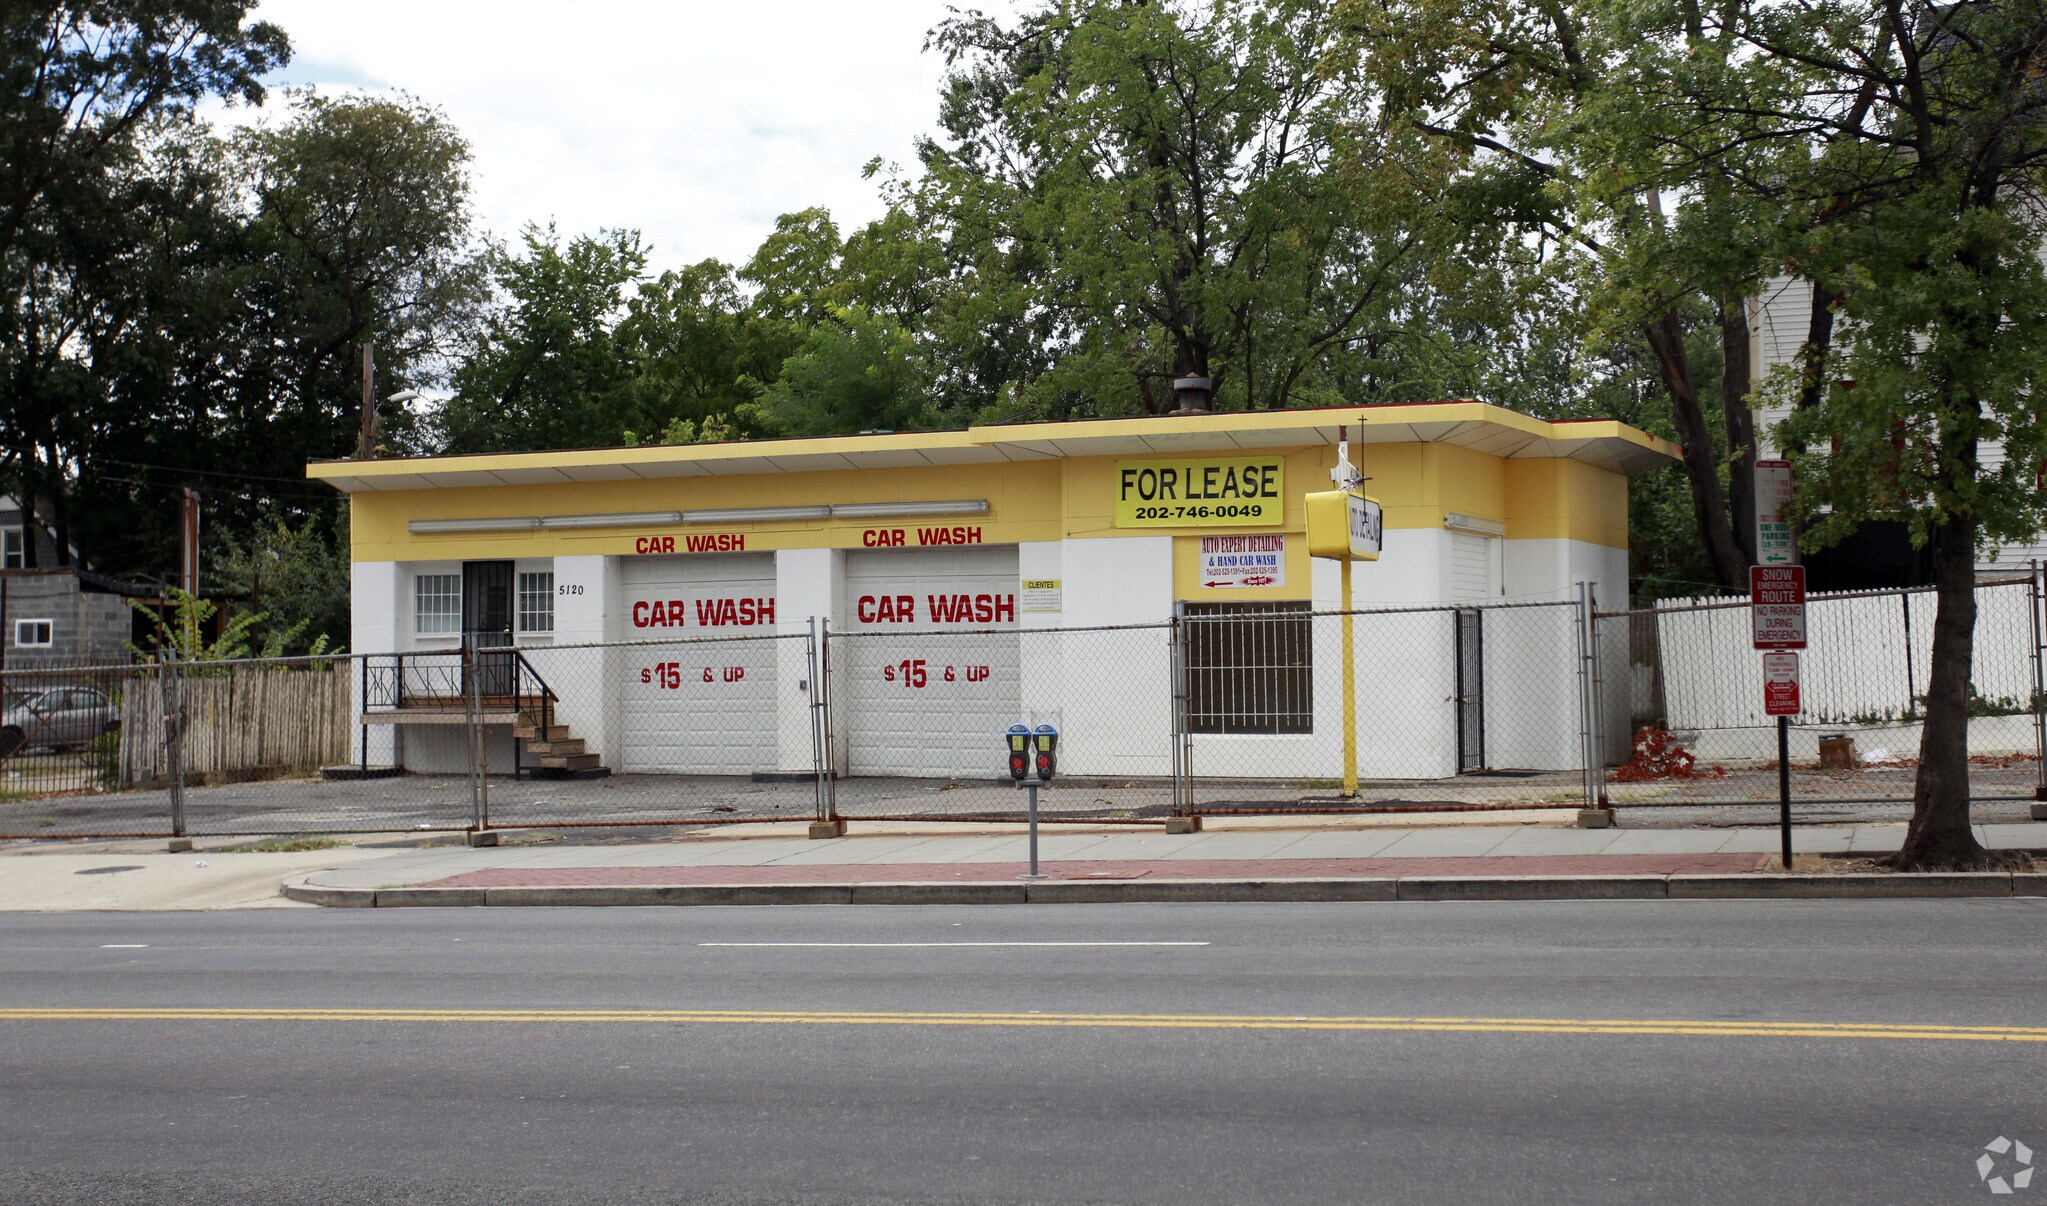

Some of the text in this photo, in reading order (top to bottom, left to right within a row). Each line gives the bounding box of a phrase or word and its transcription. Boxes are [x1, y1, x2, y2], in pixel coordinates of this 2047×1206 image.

[1121, 463, 1279, 501] FOR LEASE
[1135, 504, 1263, 519] 202-746-0049
[1760, 523, 1772, 532] ONE
[863, 526, 982, 547] CAR WASH
[1761, 532, 1791, 540] PARKING
[636, 534, 745, 554] CAR WASH
[1202, 535, 1283, 553] AUTO EXPERT DETAILING
[1209, 554, 1277, 567] & HAND CAR WASH
[1762, 568, 1793, 581] SNOW
[559, 584, 584, 596] 5120
[1028, 581, 1055, 589] CLIENTES
[1757, 581, 1798, 590] EMERGENCY
[1761, 591, 1796, 603] ROUTE
[632, 597, 775, 628] CAR WASH
[858, 595, 915, 623] CAR
[928, 593, 1014, 623] WASH
[1757, 606, 1801, 616] NO PARKING
[1766, 618, 1793, 628] DURING
[1758, 630, 1801, 641] EMERGENCY
[641, 662, 745, 689] $15 & UP
[884, 659, 990, 688] $15 & UP
